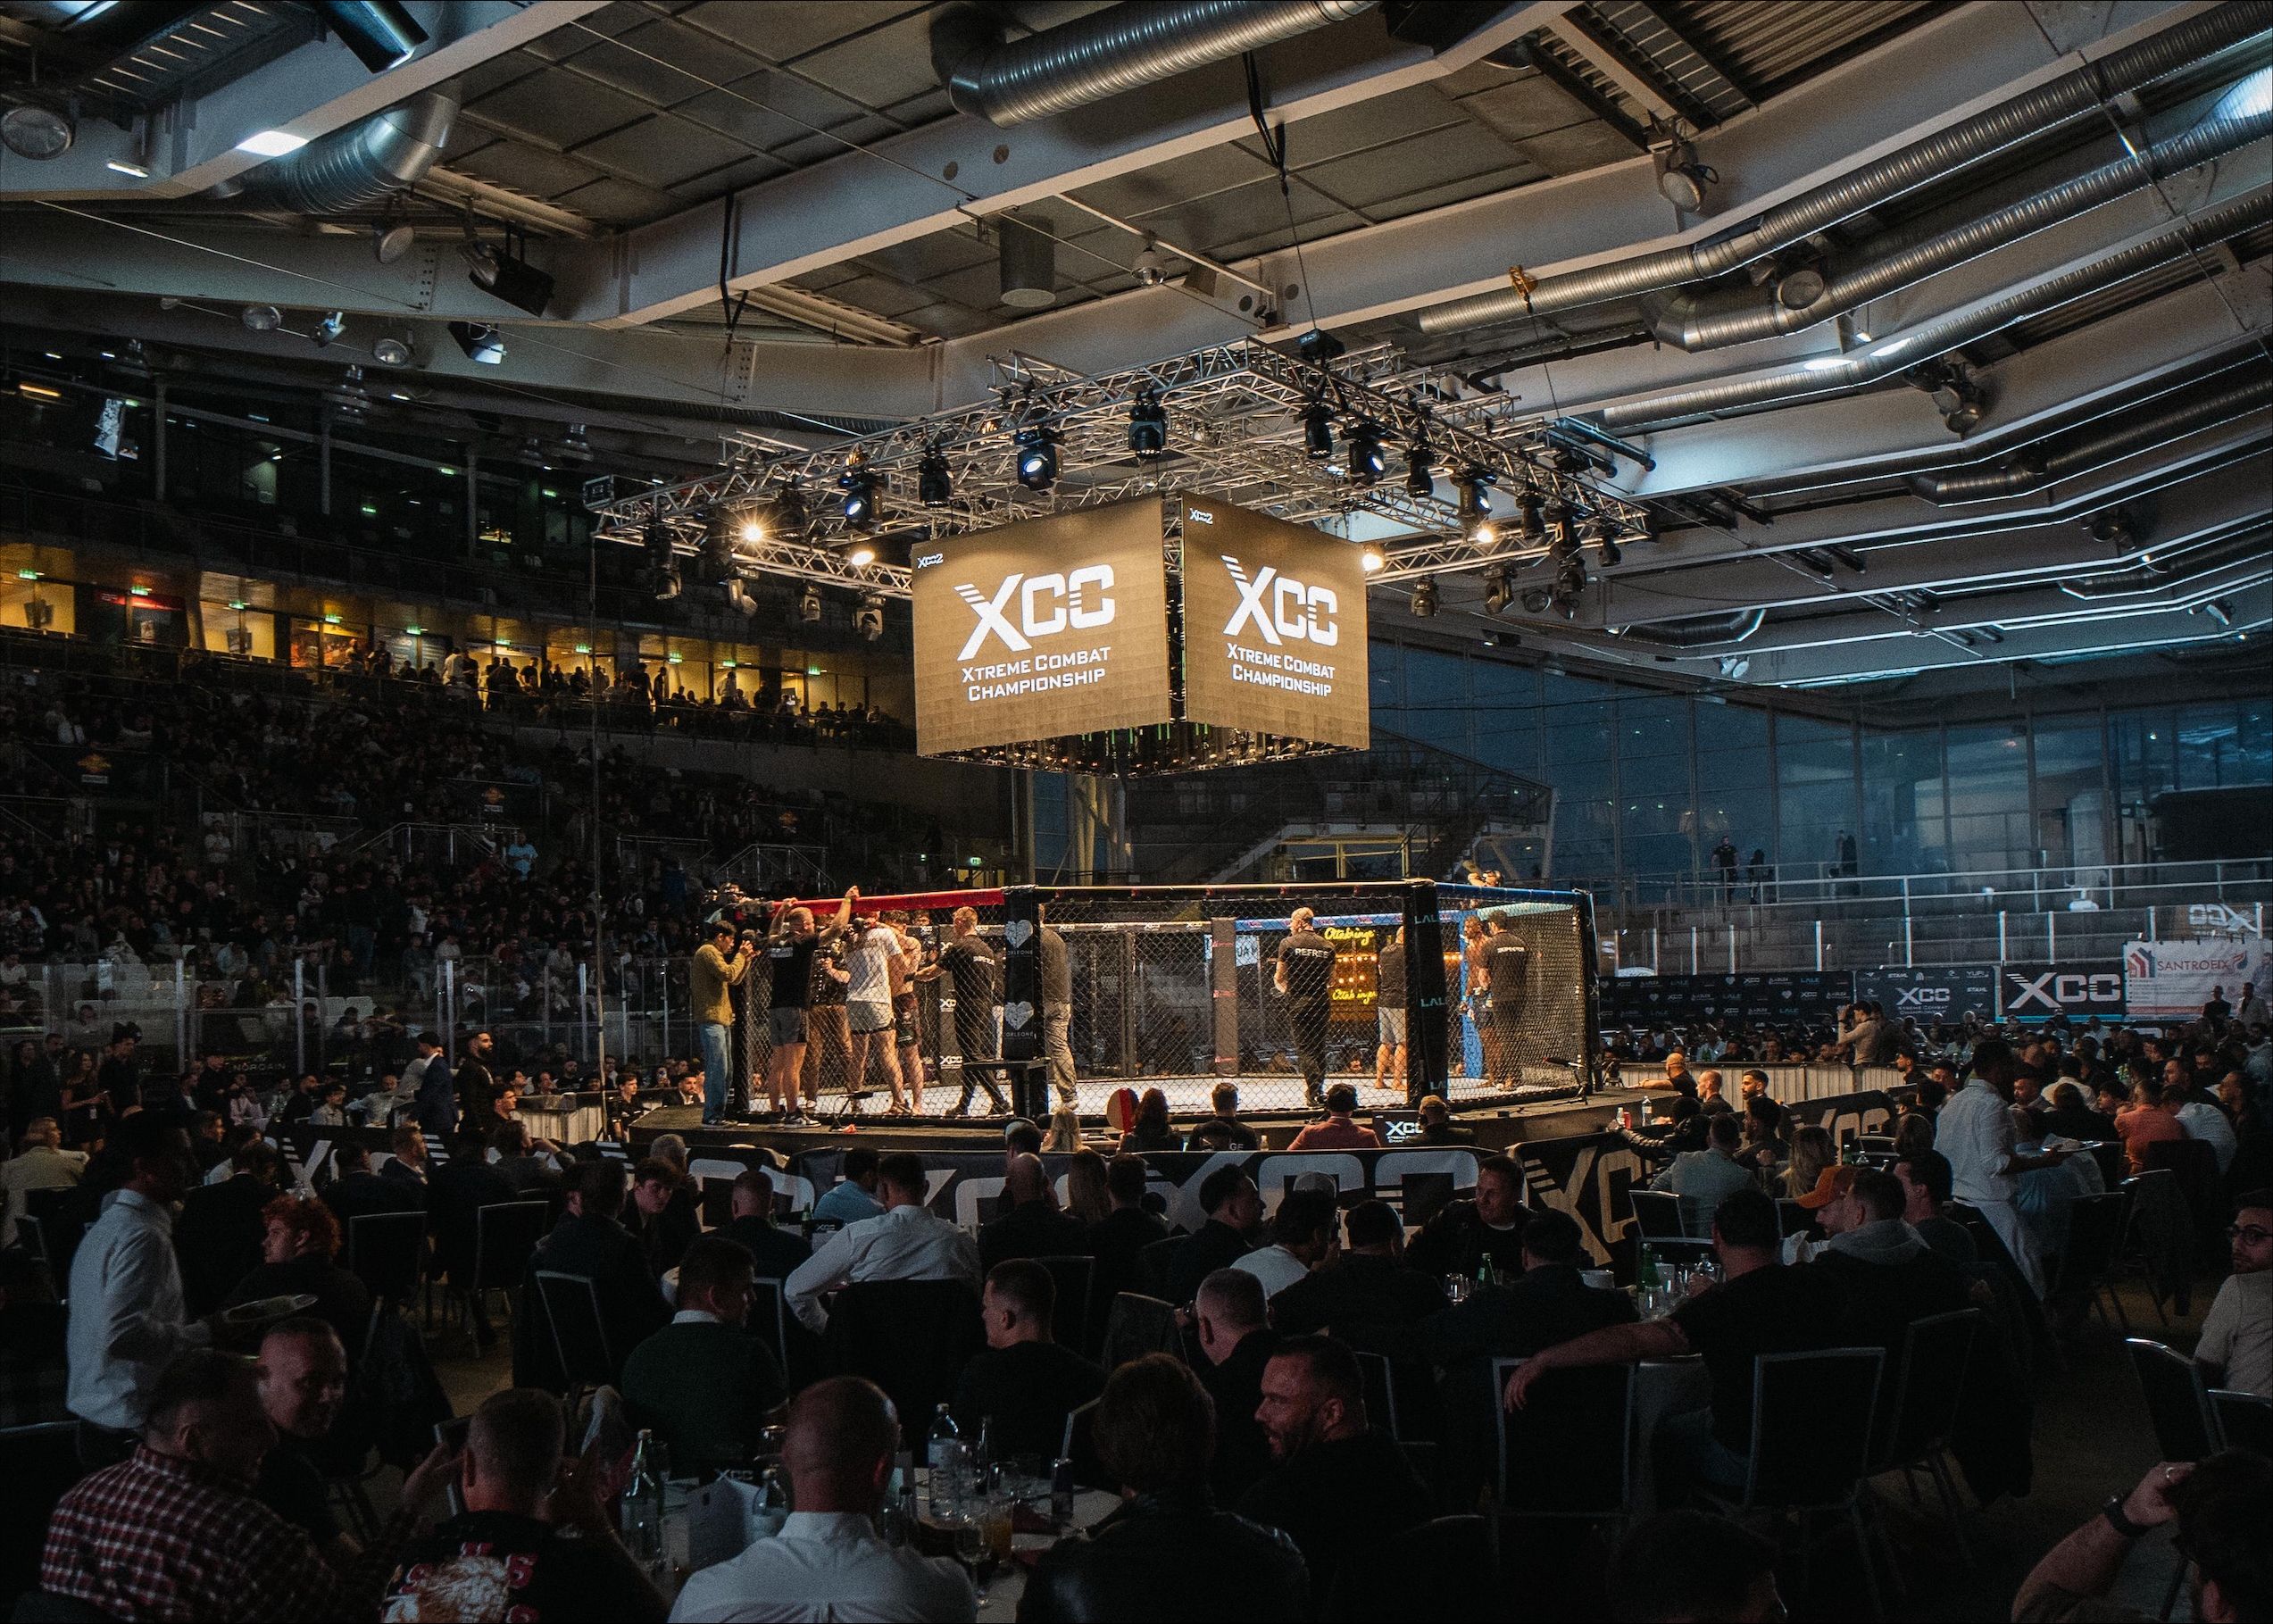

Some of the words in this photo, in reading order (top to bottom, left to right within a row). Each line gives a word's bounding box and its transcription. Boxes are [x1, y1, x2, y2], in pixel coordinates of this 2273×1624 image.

[953, 564, 1116, 662] XCC
[1221, 554, 1338, 646] XCC
[962, 659, 1031, 684] XTREME
[1035, 646, 1112, 671] COMBAT
[1227, 642, 1282, 669] XTREME
[1283, 655, 1336, 679] COMBAT
[968, 668, 1106, 702] CHAMPIONSHIP
[1232, 664, 1332, 696] CHAMPIONSHIP
[1414, 914, 1439, 925] LAL
[1421, 997, 1446, 1008] LAL
[1894, 987, 1951, 1006] XCC
[2006, 972, 2121, 1009] XCC
